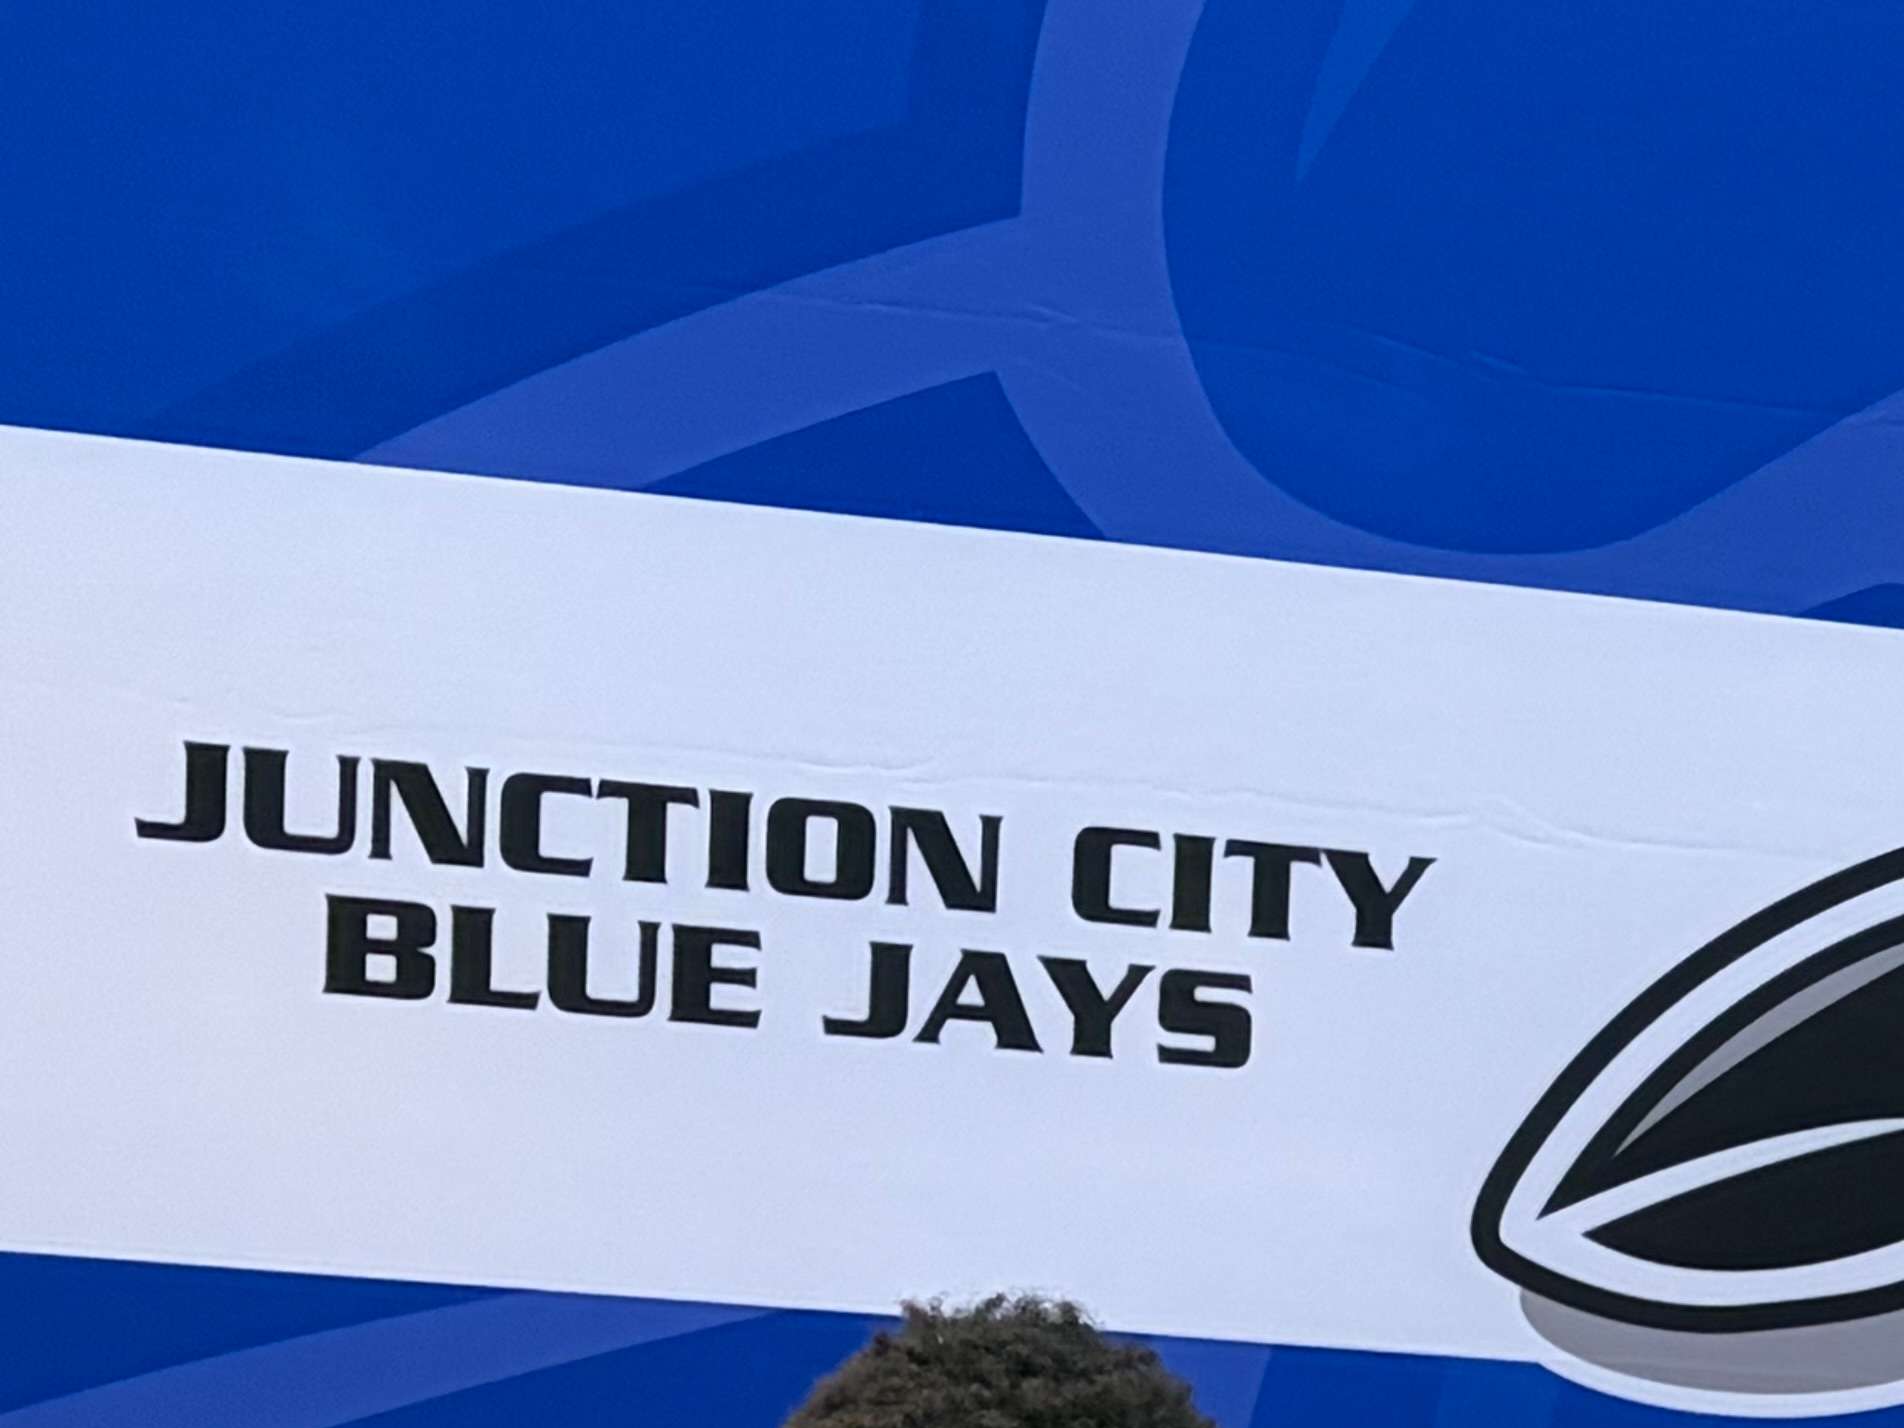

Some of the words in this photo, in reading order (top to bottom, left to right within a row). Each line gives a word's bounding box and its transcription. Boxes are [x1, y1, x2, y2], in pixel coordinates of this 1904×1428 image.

[135, 740, 1003, 913] JUNCTION
[1072, 826, 1437, 949] CITY
[322, 894, 762, 1030] BLUE
[822, 943, 1253, 1070] JAYS
